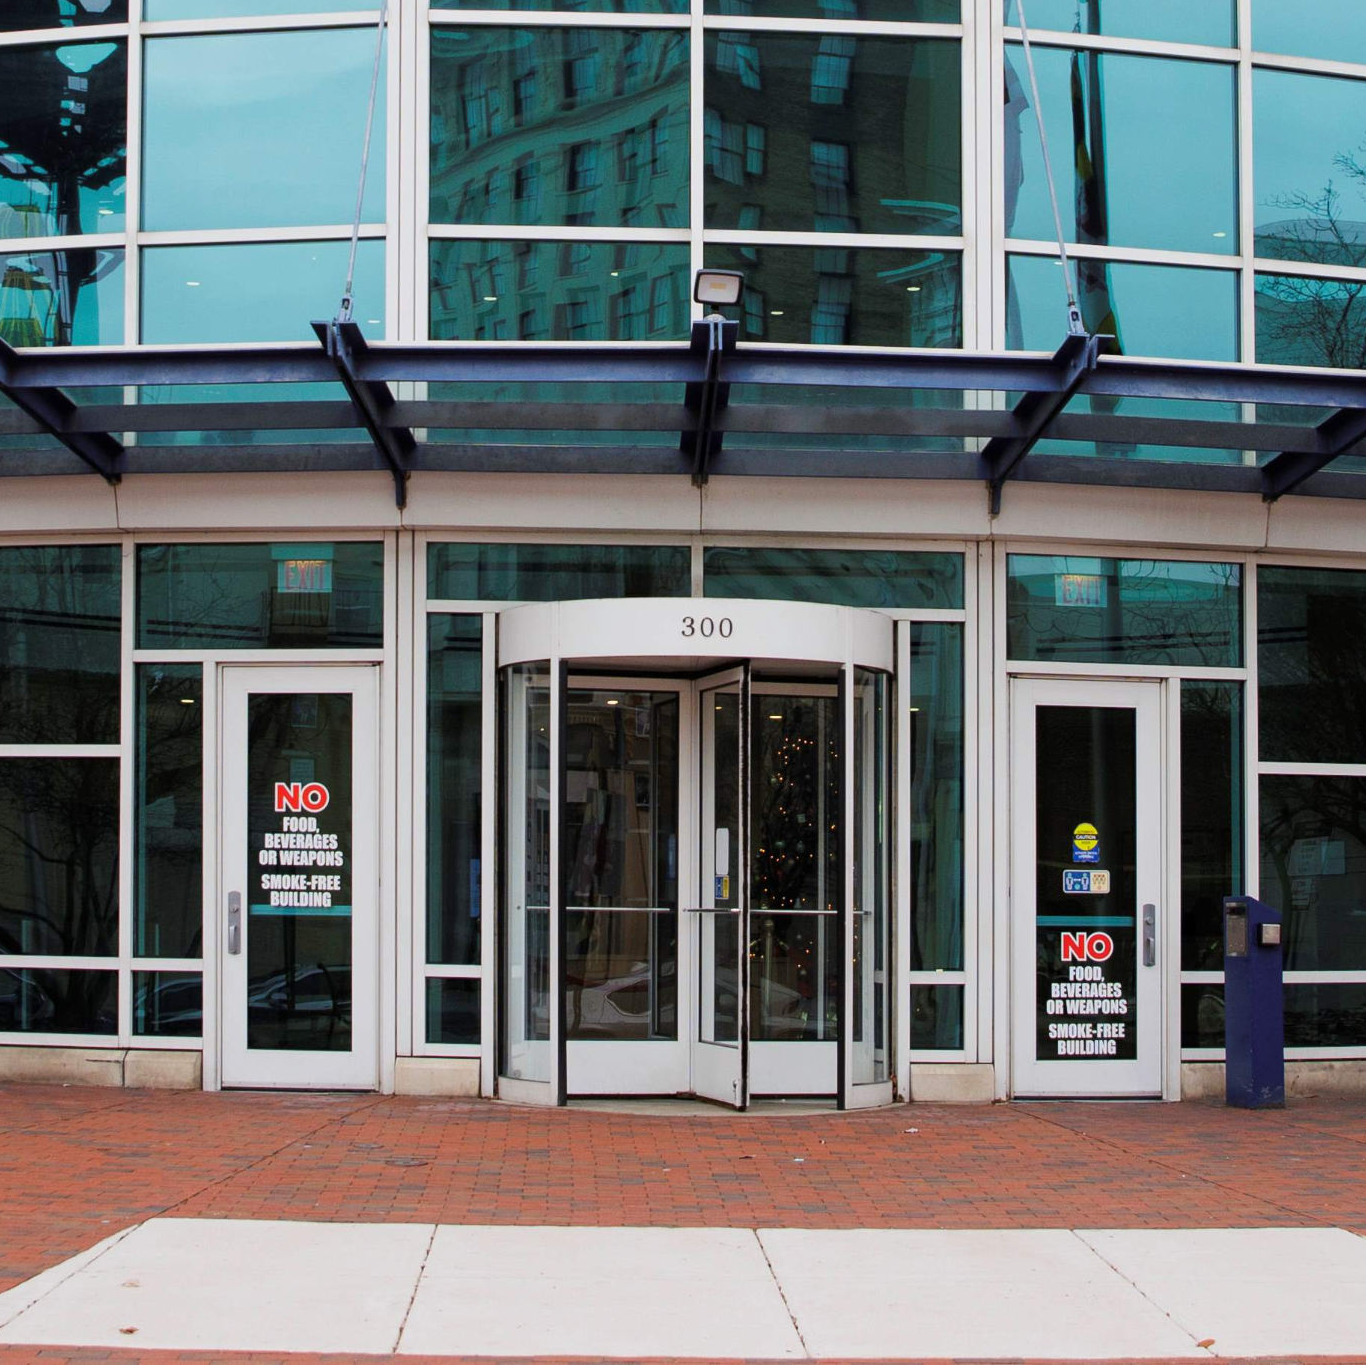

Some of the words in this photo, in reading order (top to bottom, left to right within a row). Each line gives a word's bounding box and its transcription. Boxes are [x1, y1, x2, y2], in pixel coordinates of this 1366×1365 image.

[285, 560, 325, 590] EXIT
[1062, 574, 1102, 605] EXIT
[681, 616, 733, 638] 300
[274, 782, 330, 813] NO
[282, 816, 320, 833] FOOD,
[264, 833, 338, 849] BEVERAGES
[258, 850, 277, 865] OR
[279, 850, 344, 866] WEAPONS
[261, 874, 341, 890] SMOKE-FREE
[270, 891, 332, 907] BUILDING
[1061, 931, 1114, 962] NO
[1069, 966, 1105, 982] FOOD,
[1051, 982, 1122, 998] BEVERAGES
[1046, 999, 1064, 1014] OR
[1065, 999, 1128, 1014] WEAPONS
[1048, 1023, 1126, 1038] SMOKE-FREE
[1057, 1040, 1117, 1055] BUILDING
